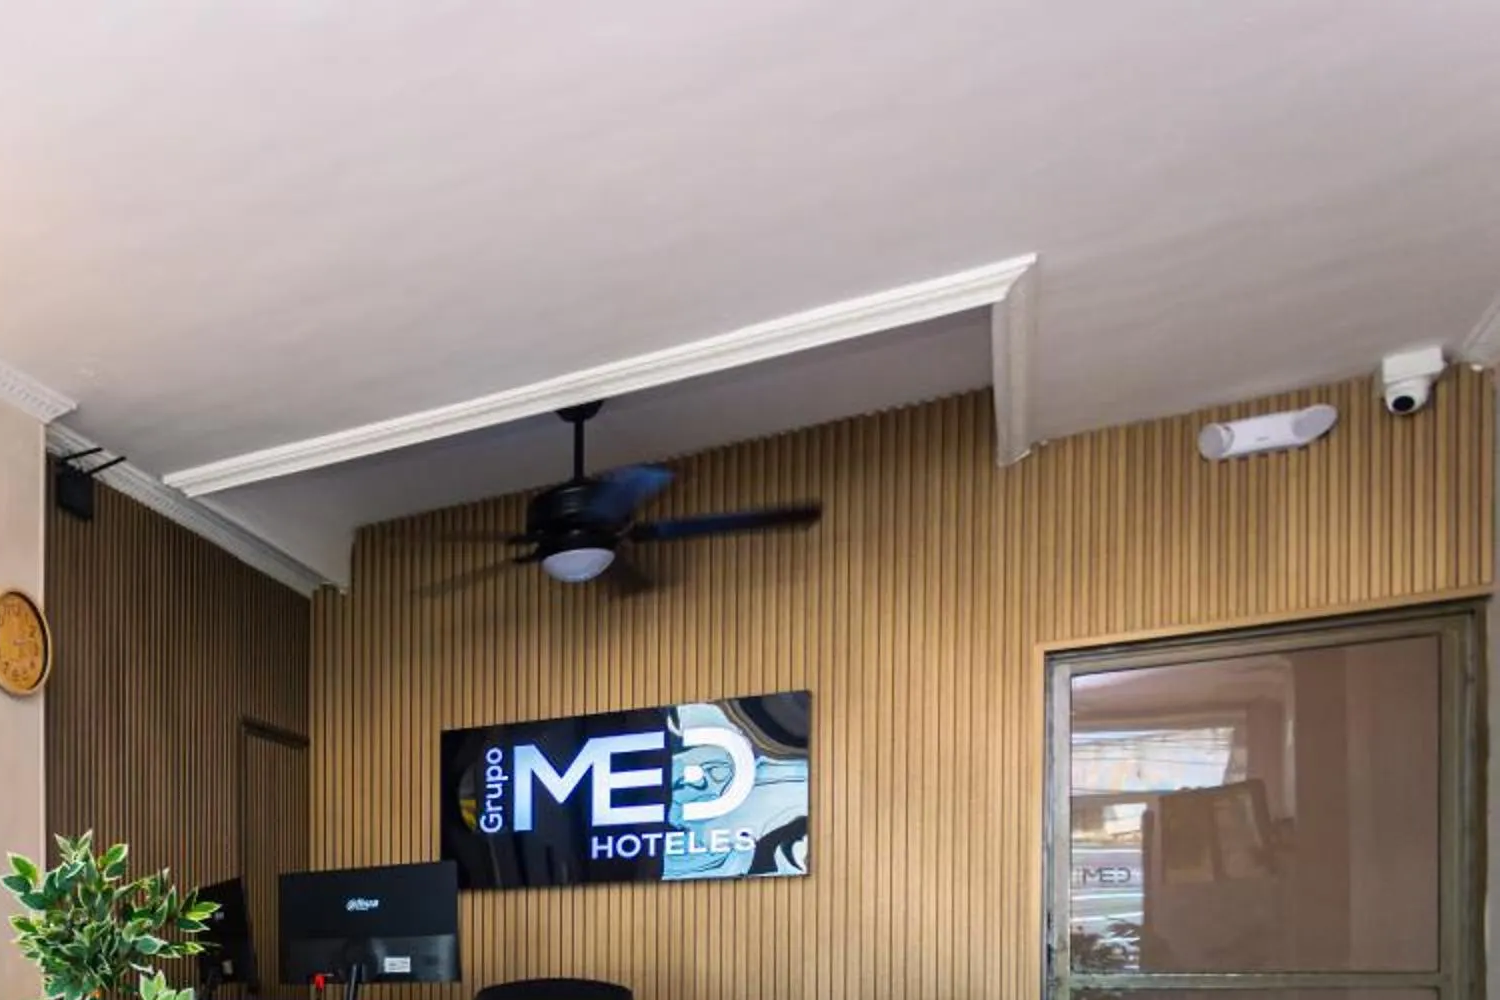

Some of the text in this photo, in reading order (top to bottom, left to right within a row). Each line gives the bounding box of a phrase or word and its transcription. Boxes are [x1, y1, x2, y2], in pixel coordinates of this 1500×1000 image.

[479, 747, 508, 834] Grupo
[513, 727, 756, 832] MED
[591, 829, 756, 860] HOTELES
